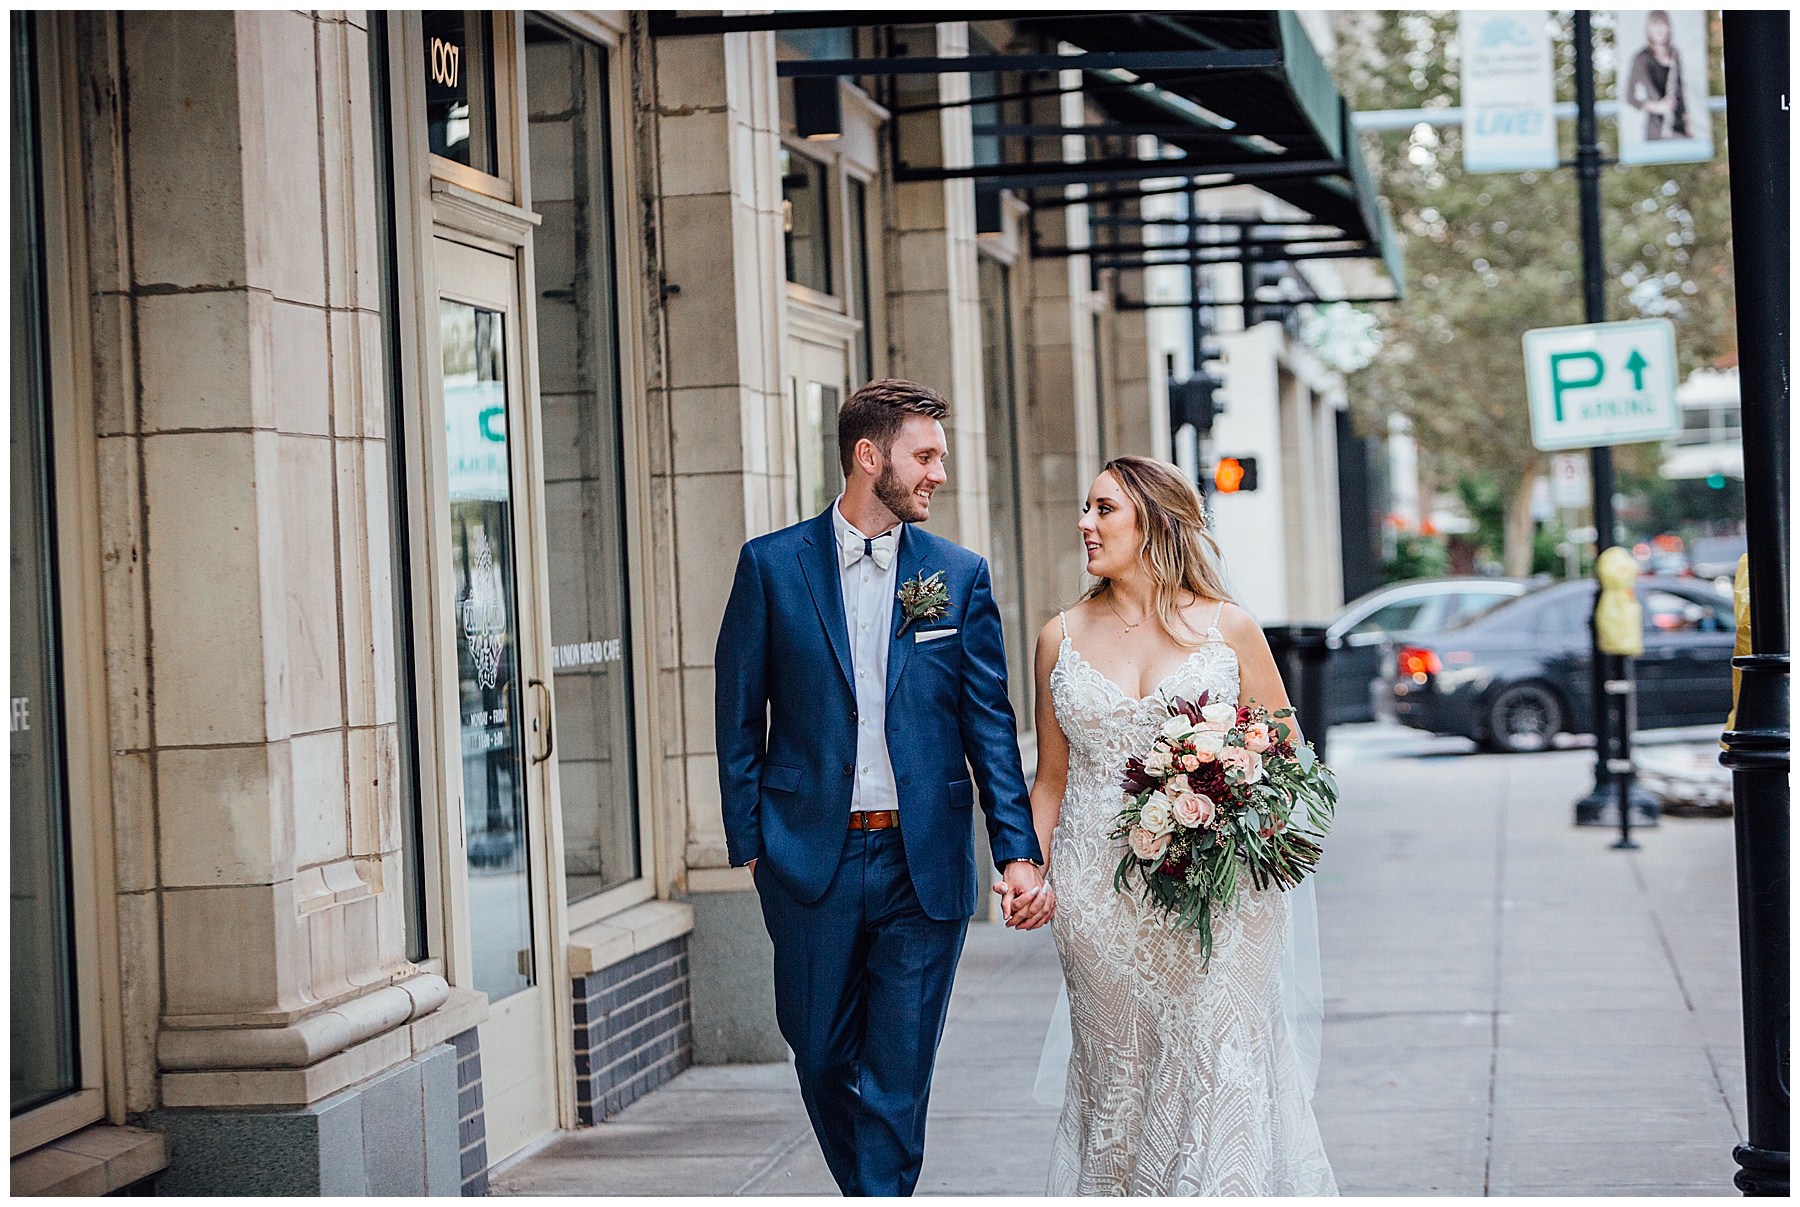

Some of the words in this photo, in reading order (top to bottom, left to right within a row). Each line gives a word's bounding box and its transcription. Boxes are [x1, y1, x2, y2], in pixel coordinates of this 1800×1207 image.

[431, 36, 459, 88] 1007
[1781, 94, 1790, 110] L
[560, 643, 580, 668] UNION
[580, 640, 603, 665] BREAD
[603, 638, 620, 663] CAFE
